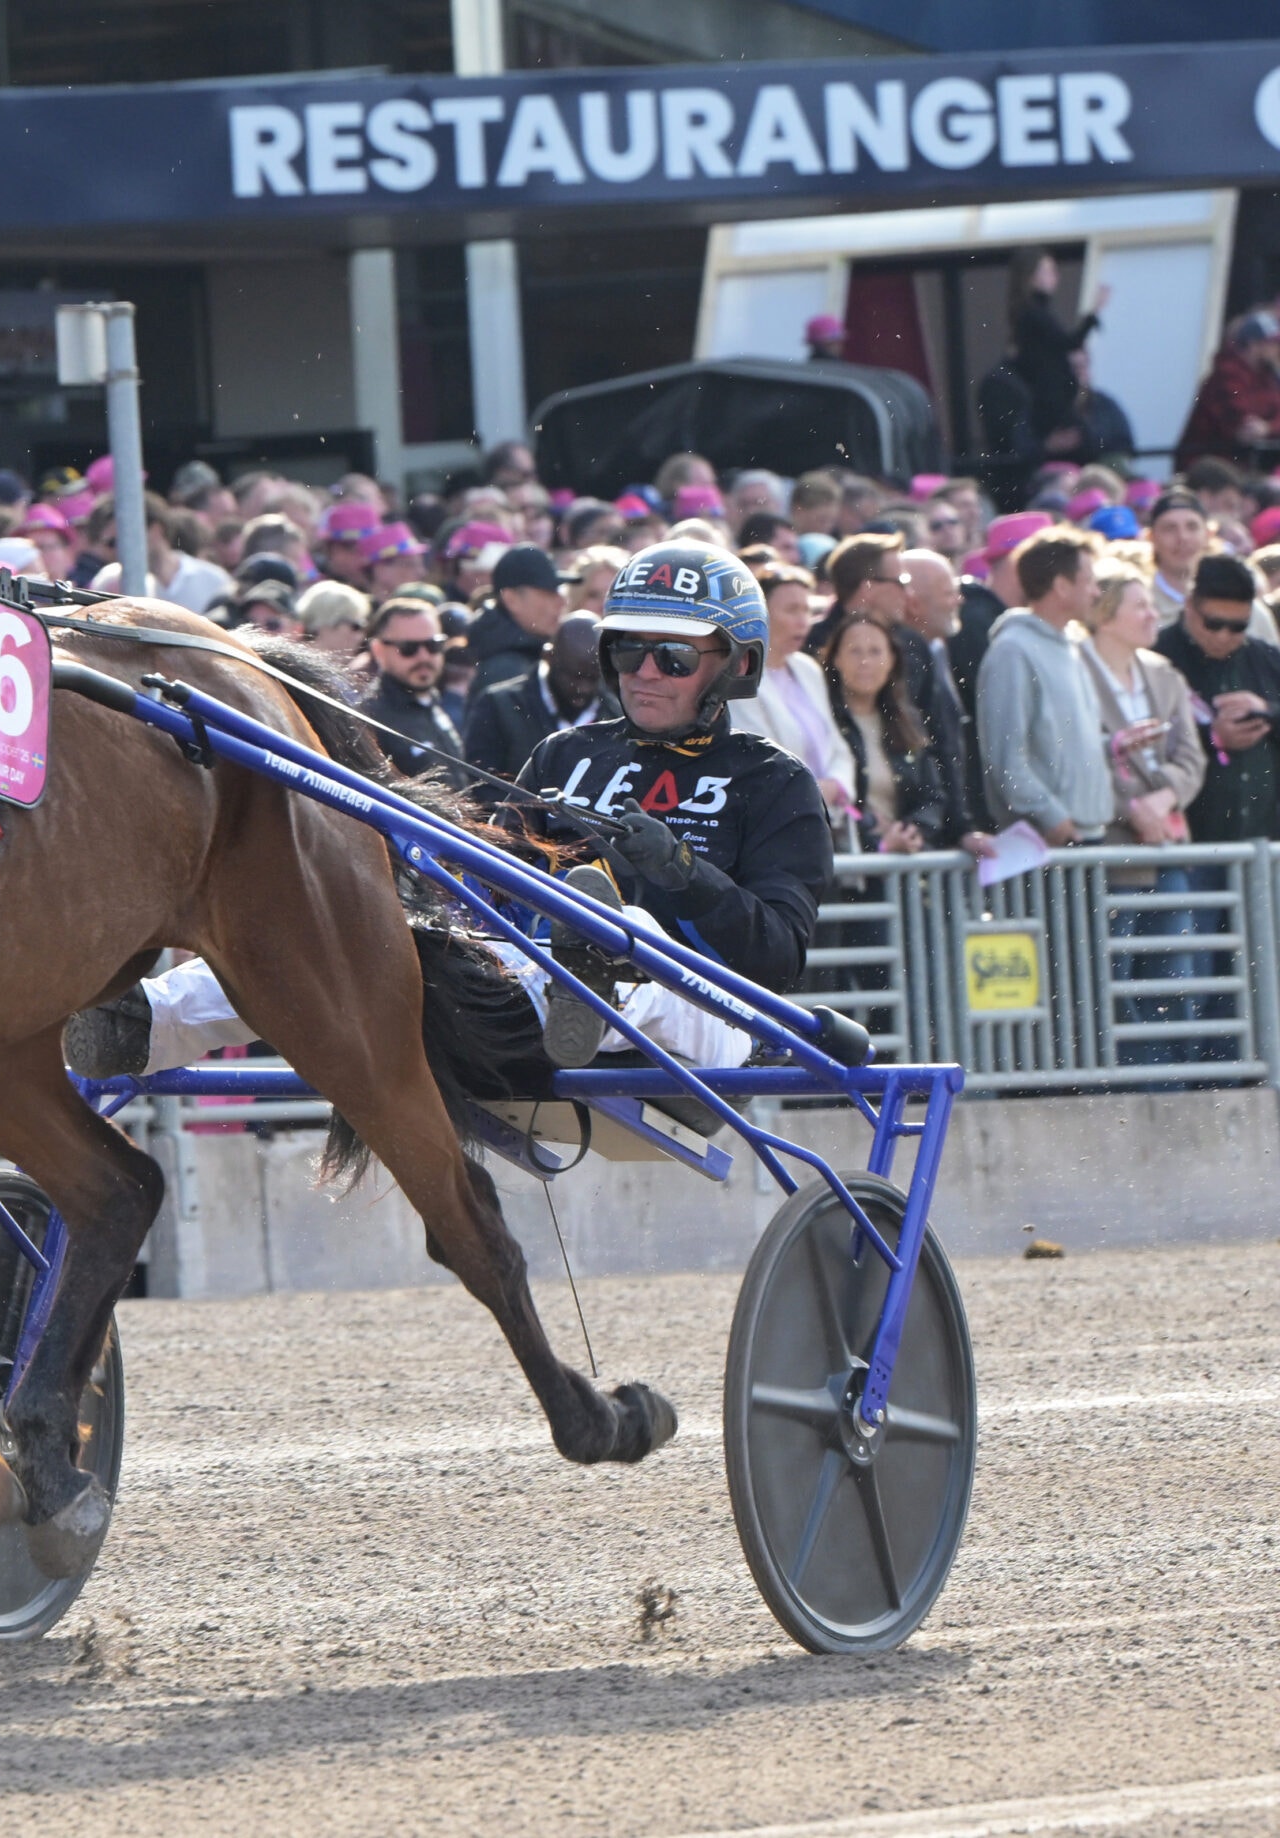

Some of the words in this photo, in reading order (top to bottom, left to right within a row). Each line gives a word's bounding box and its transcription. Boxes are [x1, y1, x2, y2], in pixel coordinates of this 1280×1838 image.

[229, 71, 1133, 199] RESTAURANGER
[613, 563, 700, 595] LEAB
[10, 767, 26, 784] DAY
[562, 757, 732, 815] LEAB
[680, 967, 756, 1021] YANKEE
